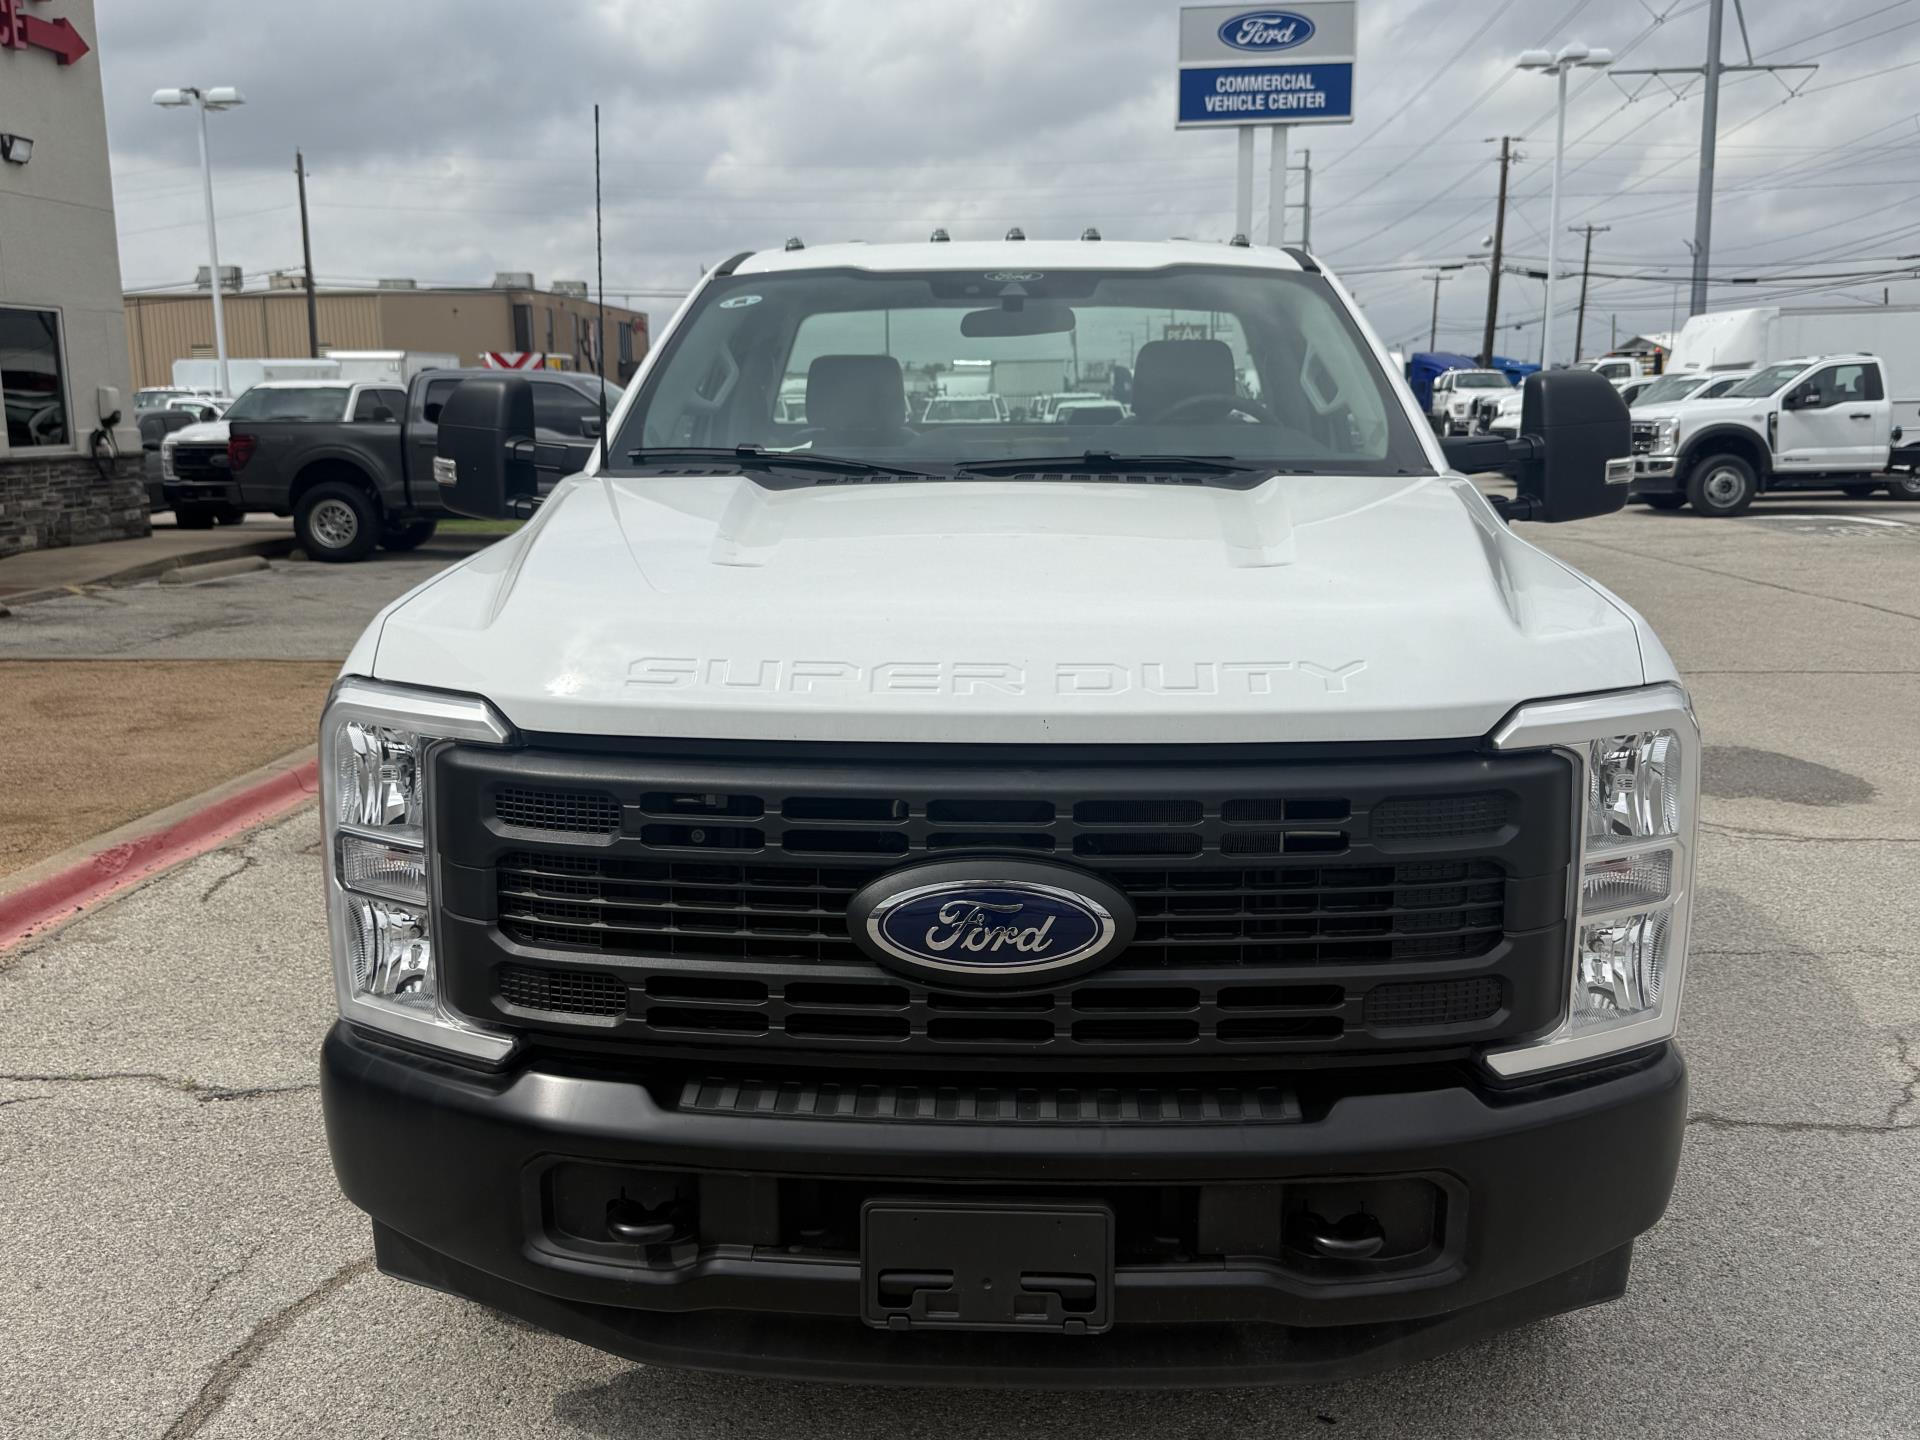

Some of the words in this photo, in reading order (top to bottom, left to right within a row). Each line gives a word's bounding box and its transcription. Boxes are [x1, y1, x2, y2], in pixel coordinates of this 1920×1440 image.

[1236, 17, 1296, 45] Ford
[1216, 74, 1315, 93] COMMERCIAL
[1205, 94, 1265, 112] VEHICLE
[1268, 93, 1326, 110] CENTER
[625, 657, 1027, 697] SUPER
[1054, 659, 1367, 697] DUTY
[925, 899, 1057, 953] Ford
